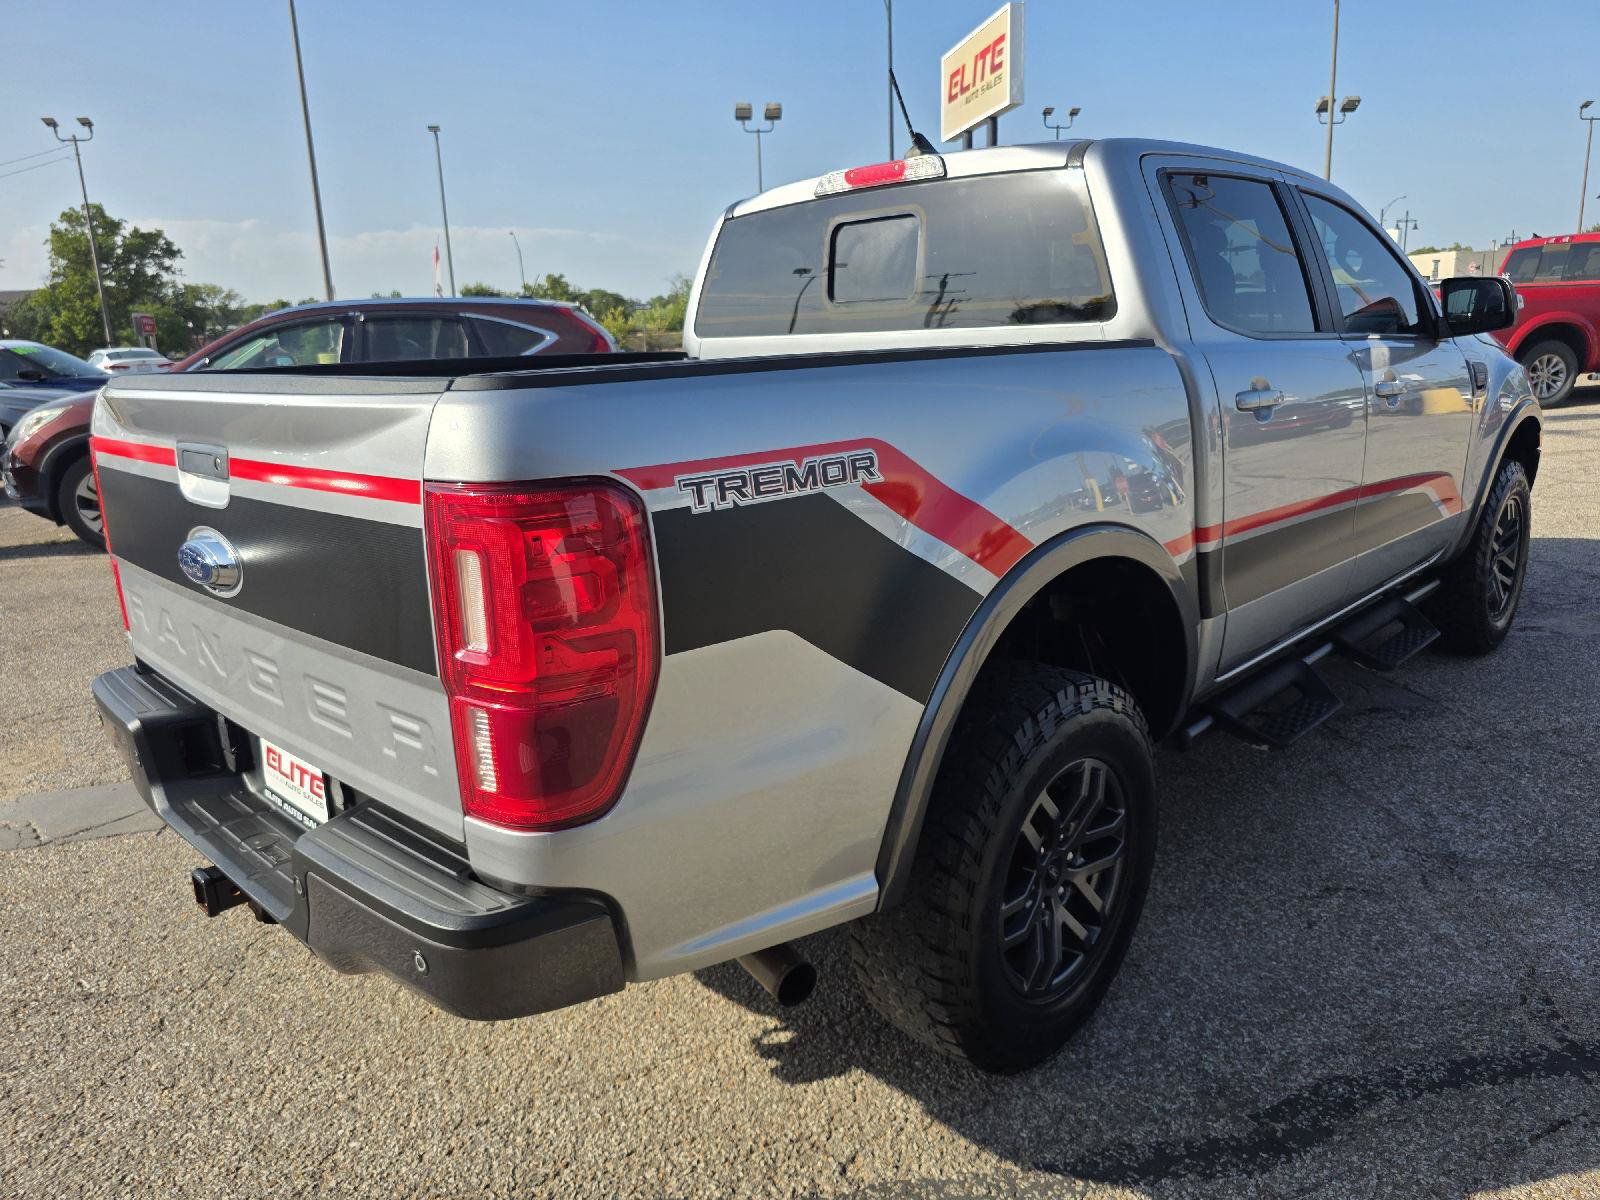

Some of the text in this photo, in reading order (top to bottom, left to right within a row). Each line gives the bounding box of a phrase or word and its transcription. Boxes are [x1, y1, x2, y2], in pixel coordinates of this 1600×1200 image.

[948, 33, 1006, 104] ELITE
[675, 449, 884, 514] TREMOR
[128, 589, 438, 776] RANGER
[266, 746, 325, 799] ELITE
